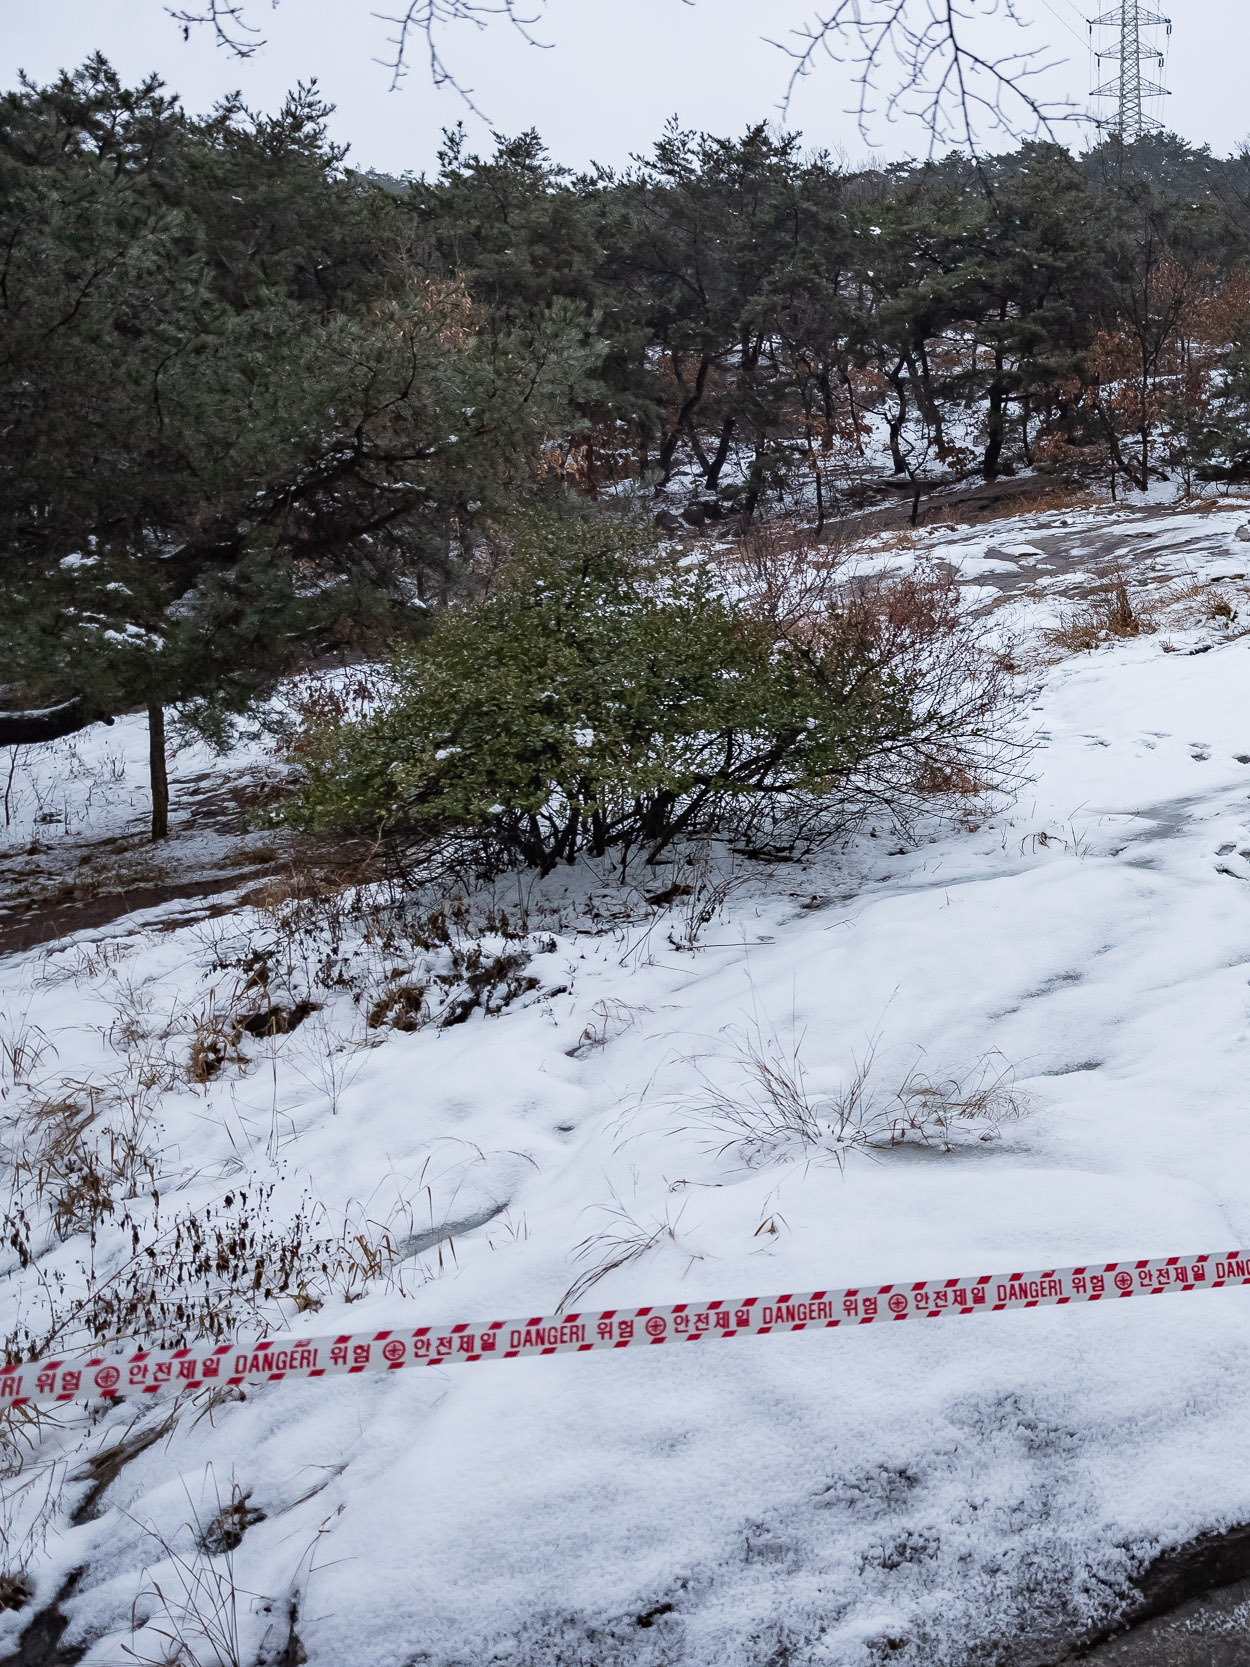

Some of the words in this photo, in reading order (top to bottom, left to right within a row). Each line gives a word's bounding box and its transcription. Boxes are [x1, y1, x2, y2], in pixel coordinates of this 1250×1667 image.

[36, 1370, 82, 1394] 위험
[129, 1357, 220, 1385] 안전제일
[330, 1344, 370, 1365] 위험
[414, 1333, 496, 1358] 안전제일
[597, 1320, 634, 1340] 위험
[674, 1309, 750, 1333] 안전제일
[843, 1297, 878, 1317] 위험
[914, 1287, 986, 1310] 안전제일
[1072, 1275, 1105, 1294] 위험
[1138, 1264, 1206, 1287] 안전제일
